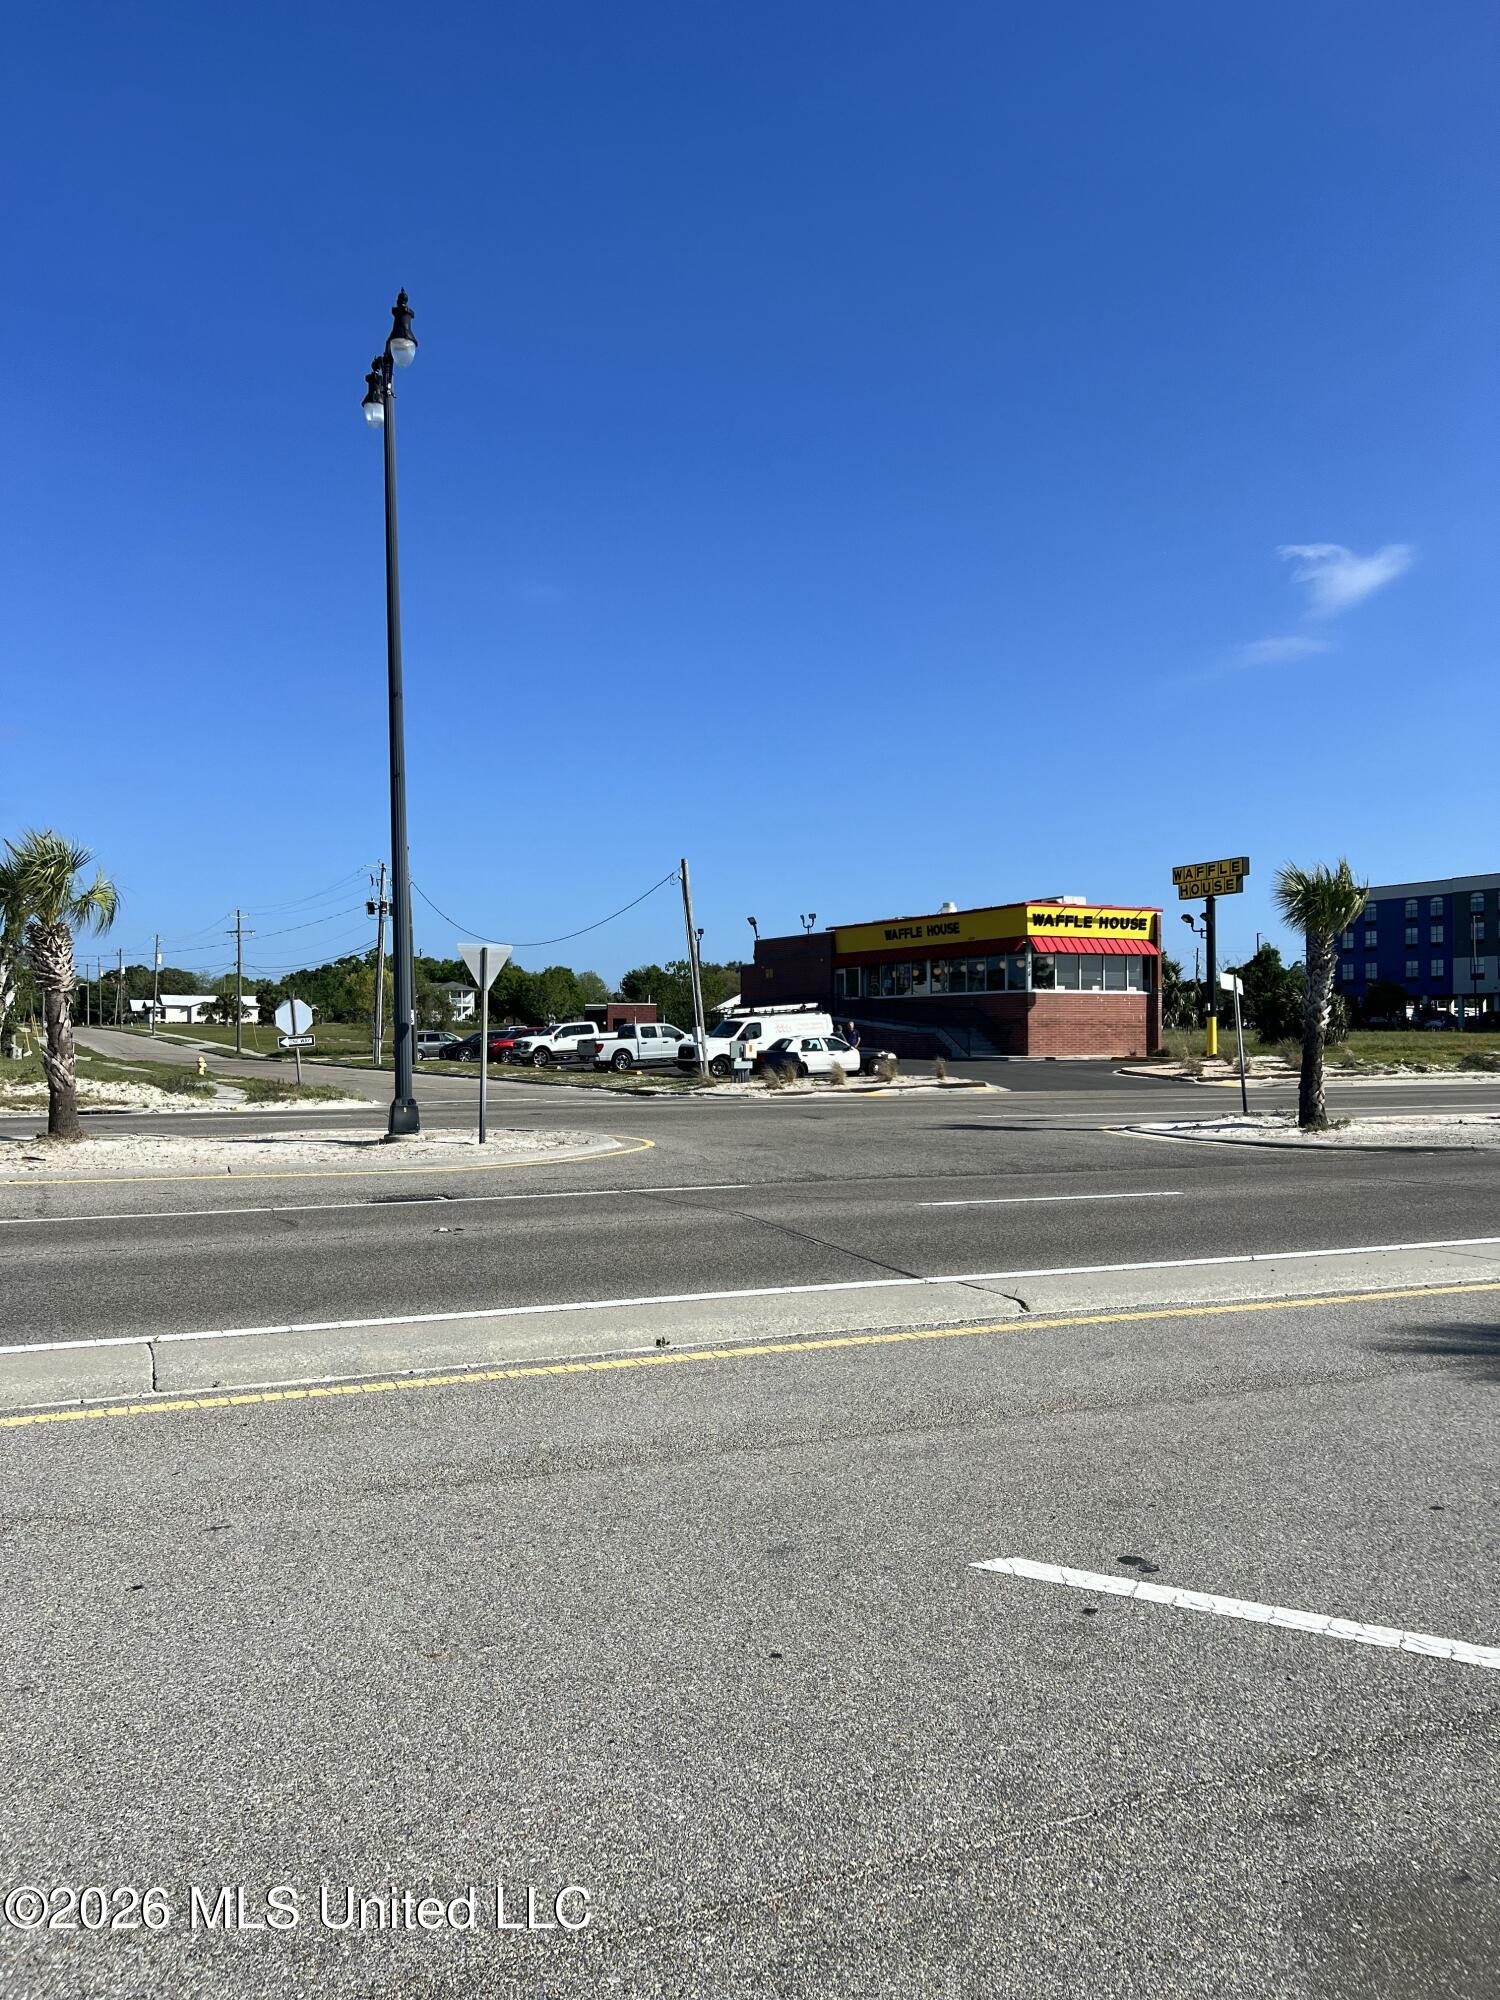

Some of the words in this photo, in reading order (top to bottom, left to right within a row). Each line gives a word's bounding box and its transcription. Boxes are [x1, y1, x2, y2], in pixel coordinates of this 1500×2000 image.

[1173, 860, 1241, 881] WAFFLE
[1180, 878, 1234, 897] HOUSE
[1032, 913, 1093, 928] WAFFLE
[1099, 916, 1148, 930] HOUSE
[884, 926, 923, 941] WAFFLE
[926, 922, 961, 937] HOUSE
